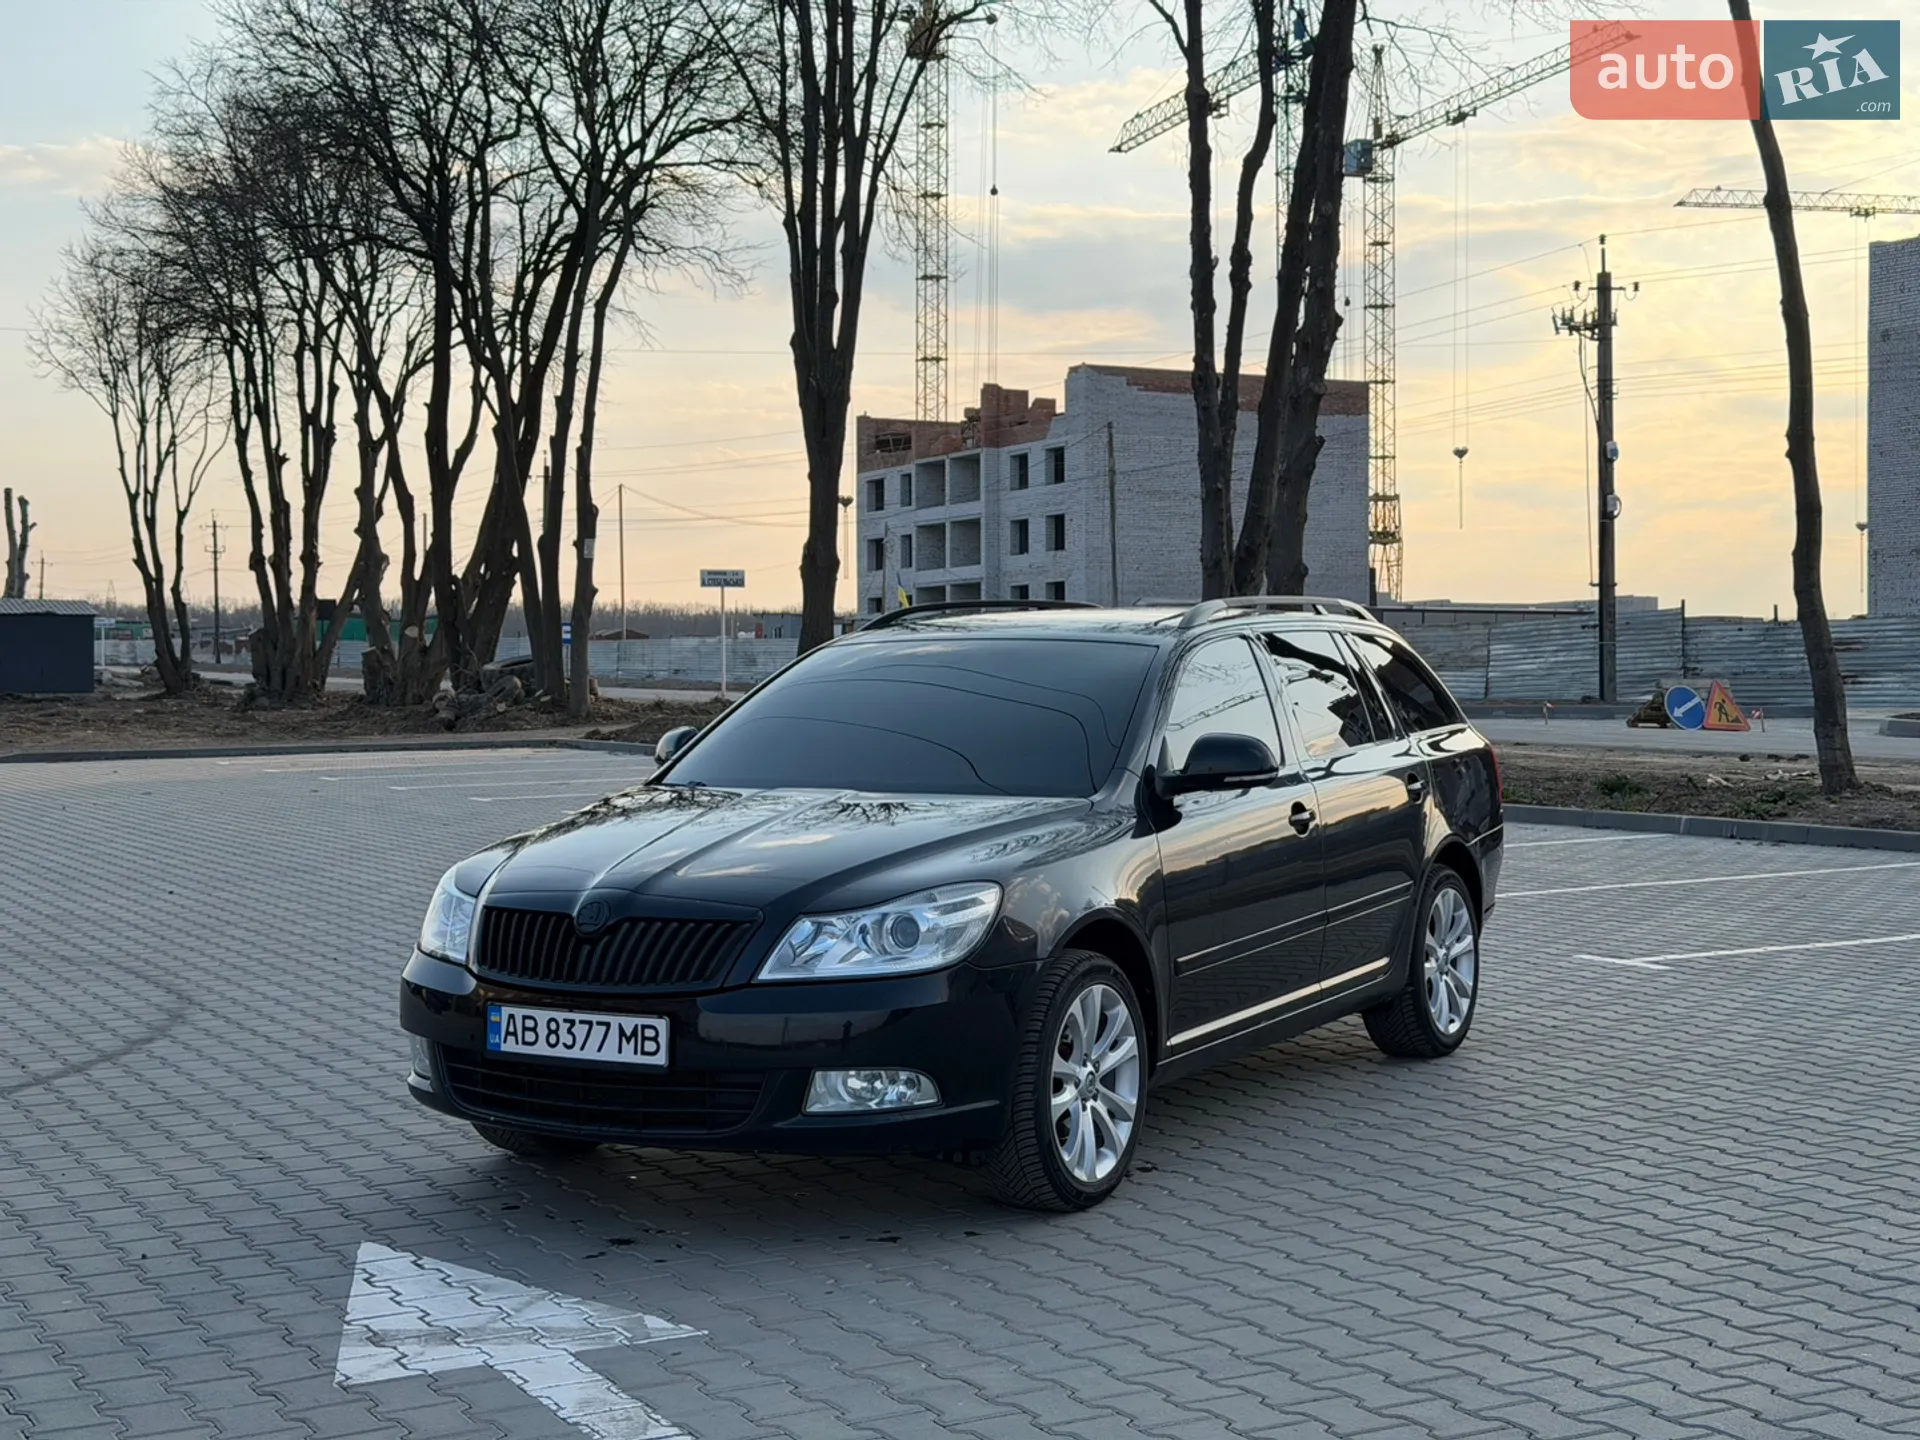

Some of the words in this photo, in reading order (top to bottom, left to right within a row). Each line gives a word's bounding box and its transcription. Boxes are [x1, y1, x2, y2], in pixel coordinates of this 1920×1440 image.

[489, 1034, 500, 1044] UA
[503, 1013, 539, 1047] AB
[545, 1017, 612, 1053] 8377
[617, 1022, 661, 1057] MB
